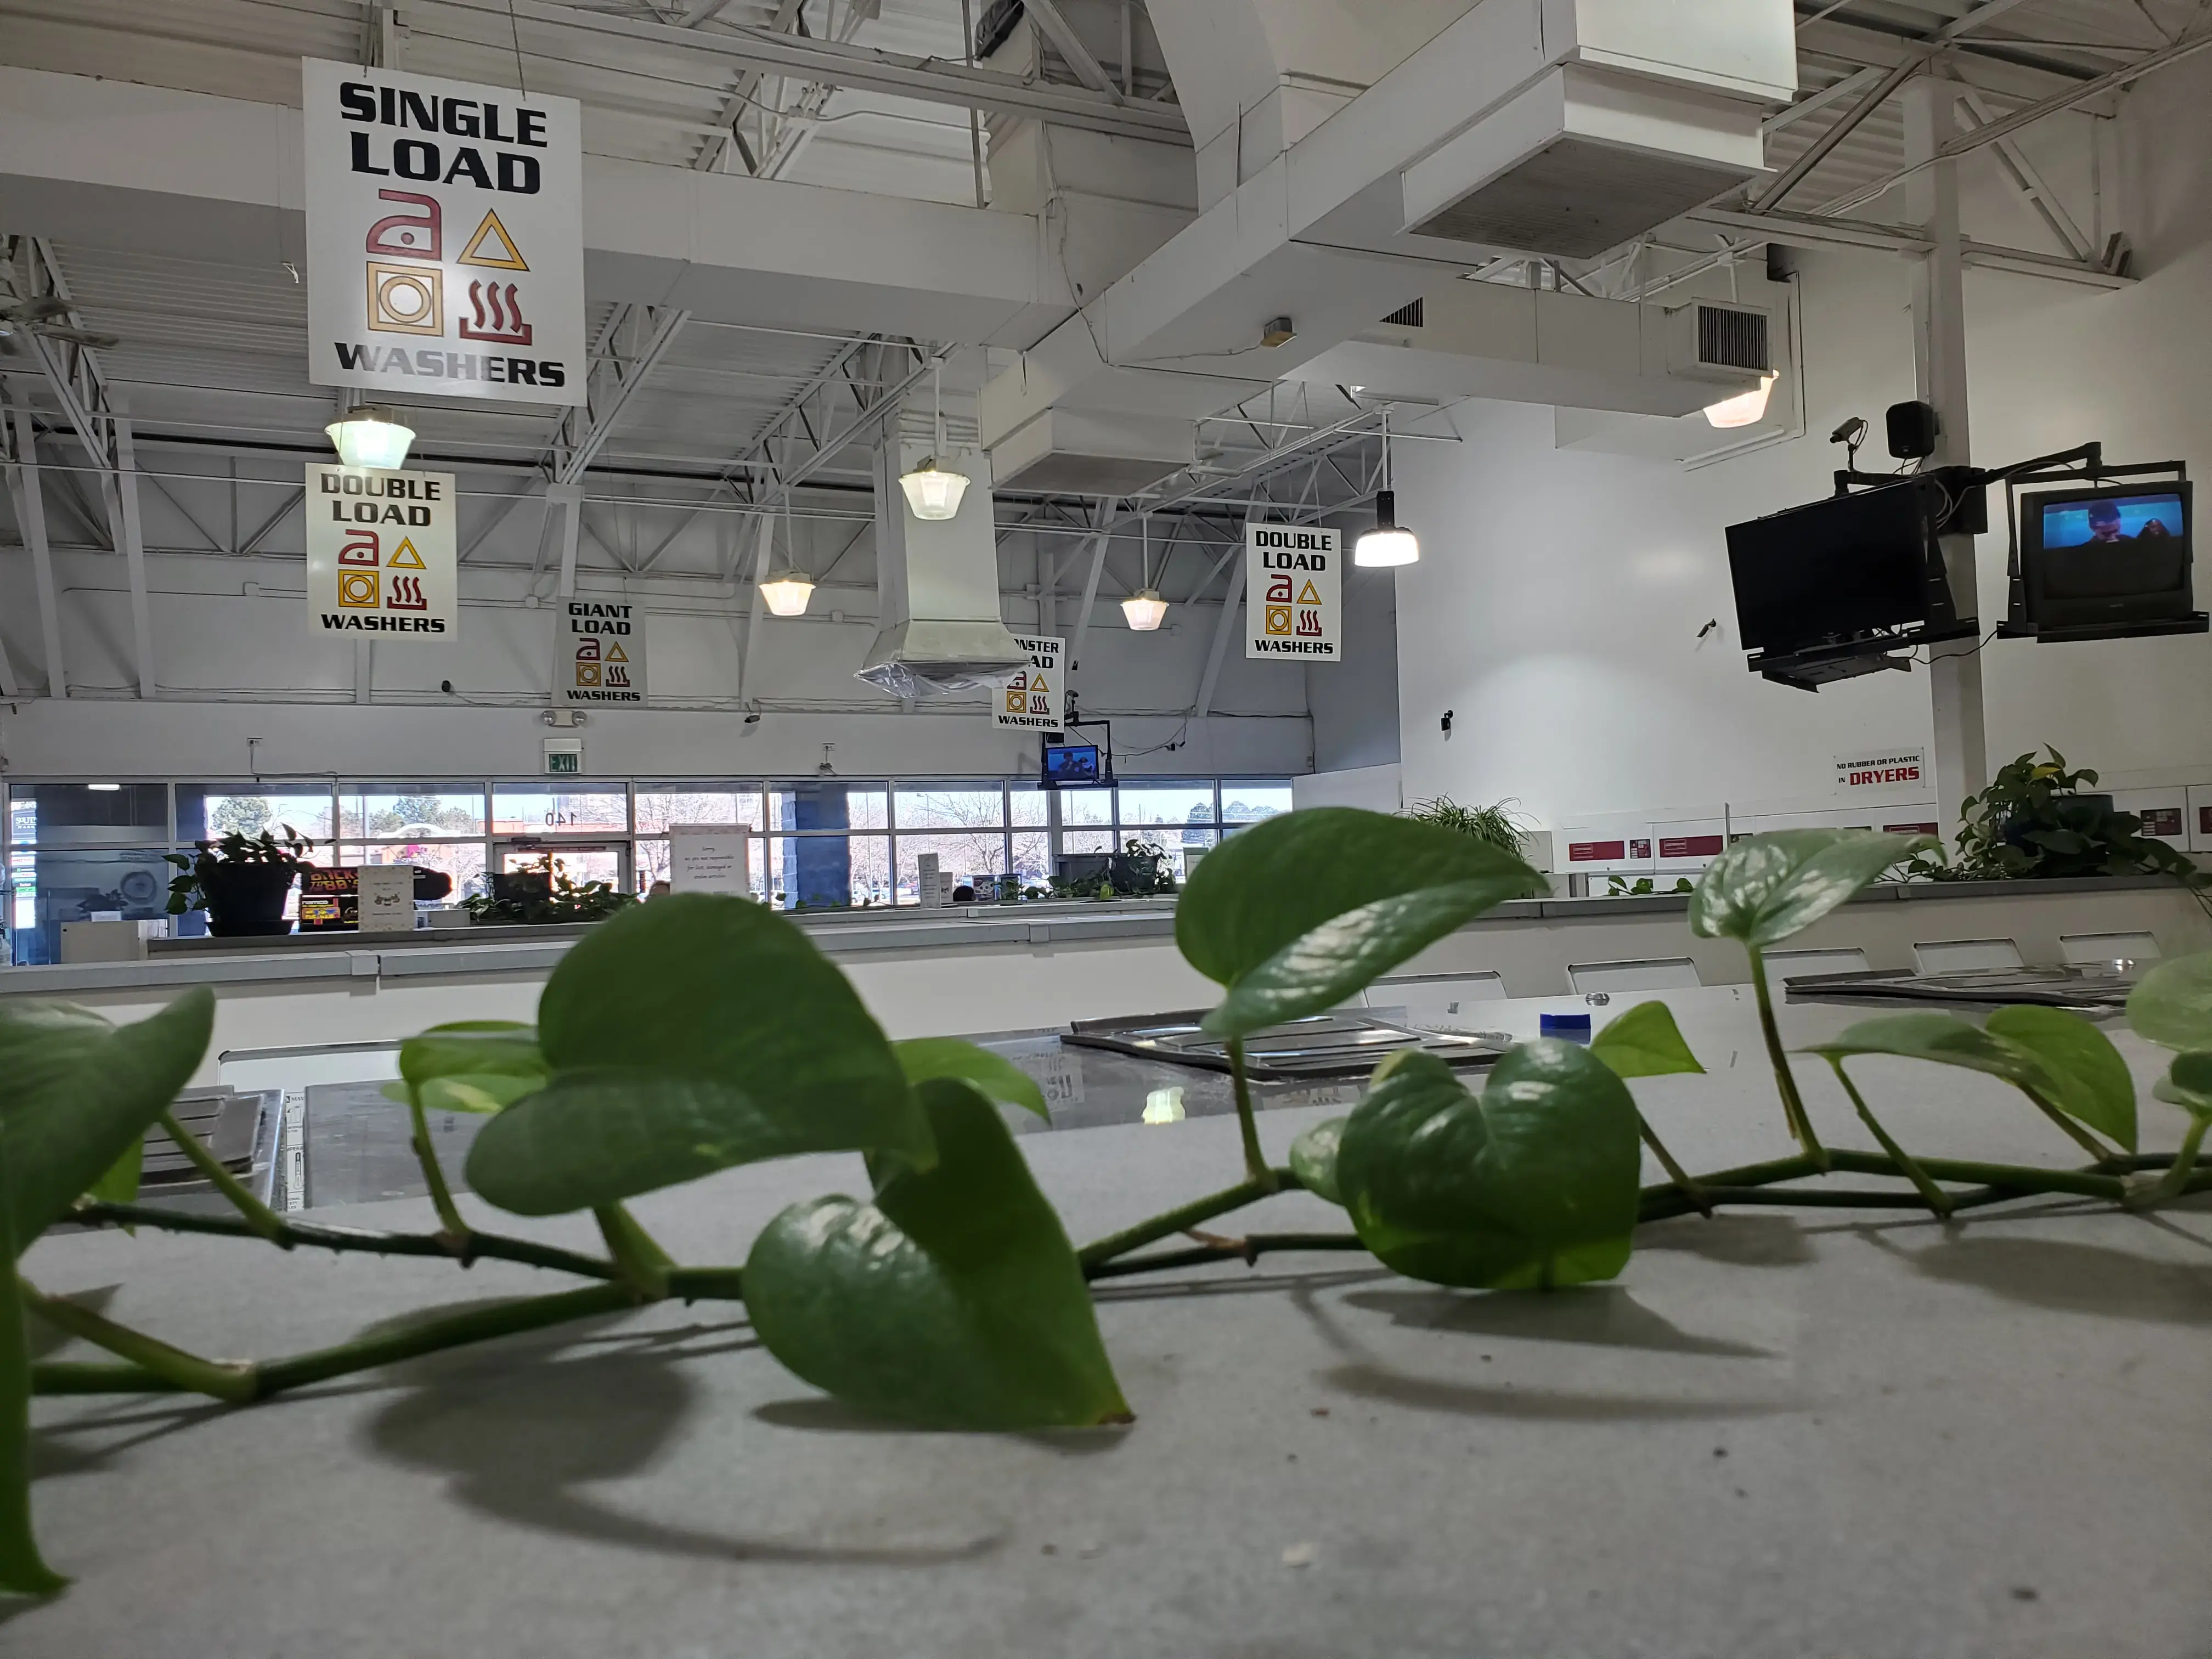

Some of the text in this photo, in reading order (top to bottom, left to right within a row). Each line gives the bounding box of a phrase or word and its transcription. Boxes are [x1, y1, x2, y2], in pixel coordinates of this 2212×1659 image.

[340, 82, 548, 148] SINGLE
[350, 131, 540, 195] LOAD
[334, 342, 565, 387] WASHERS
[321, 473, 441, 501] DOUBLE
[332, 500, 431, 527] LOAD
[1256, 531, 1332, 551] DOUBLE
[1263, 551, 1326, 571] LOAD
[568, 602, 633, 619] GIANT
[320, 614, 445, 633] WASHERS
[572, 618, 631, 635] LOAD
[1255, 640, 1333, 654] WASHERS
[1028, 655, 1054, 669] AD
[566, 690, 641, 702] WASHERS
[998, 715, 1058, 727] WASHERS
[550, 755, 577, 771] EXIT
[1847, 760, 1876, 769] RUBBER
[1888, 755, 1920, 764] PLASTIC
[1849, 766, 1920, 786] DRYERS
